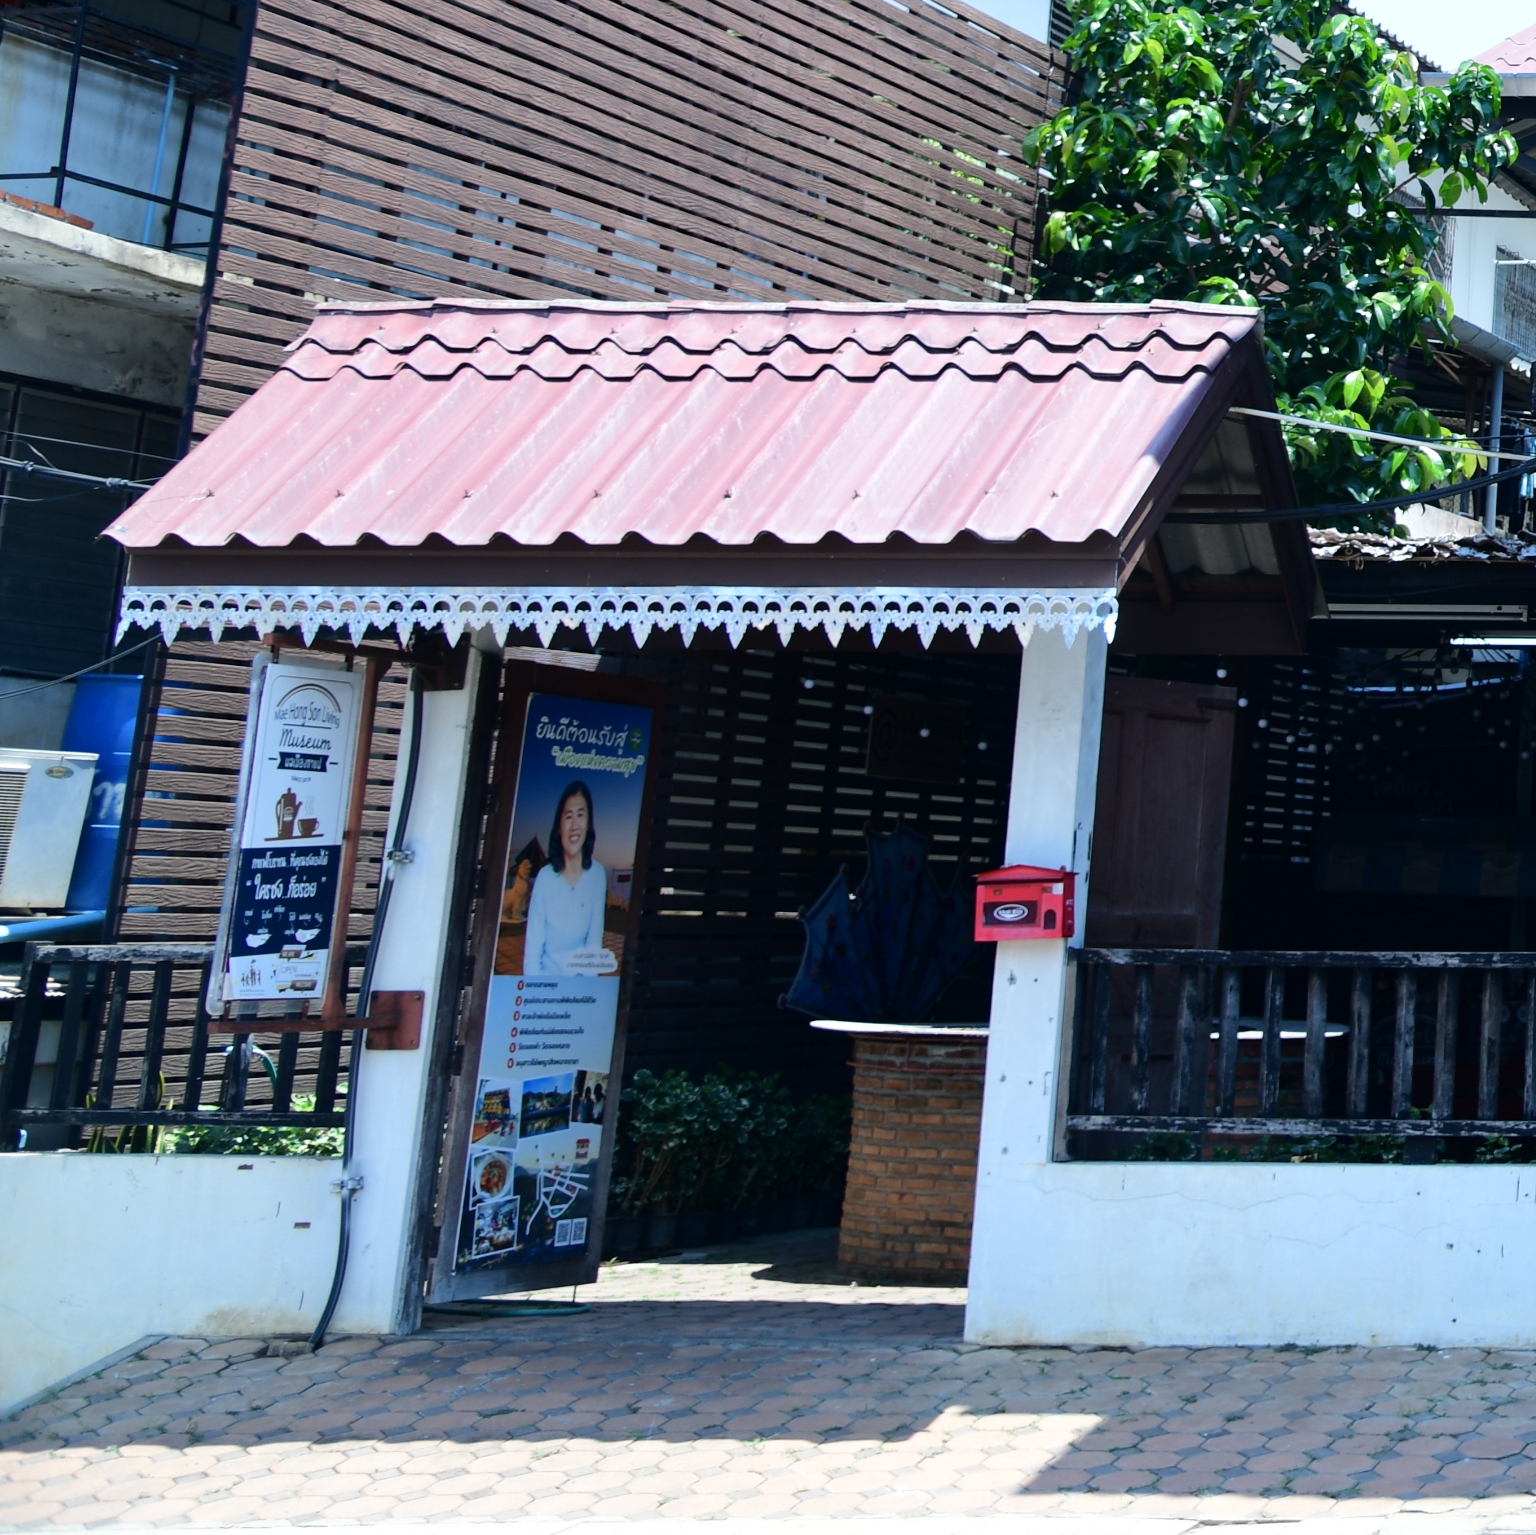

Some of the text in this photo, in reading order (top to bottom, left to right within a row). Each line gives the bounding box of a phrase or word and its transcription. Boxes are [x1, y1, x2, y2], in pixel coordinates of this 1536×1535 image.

[278, 728, 332, 751] Museum
[536, 716, 629, 755] ยินดีต้อนรับสู่
